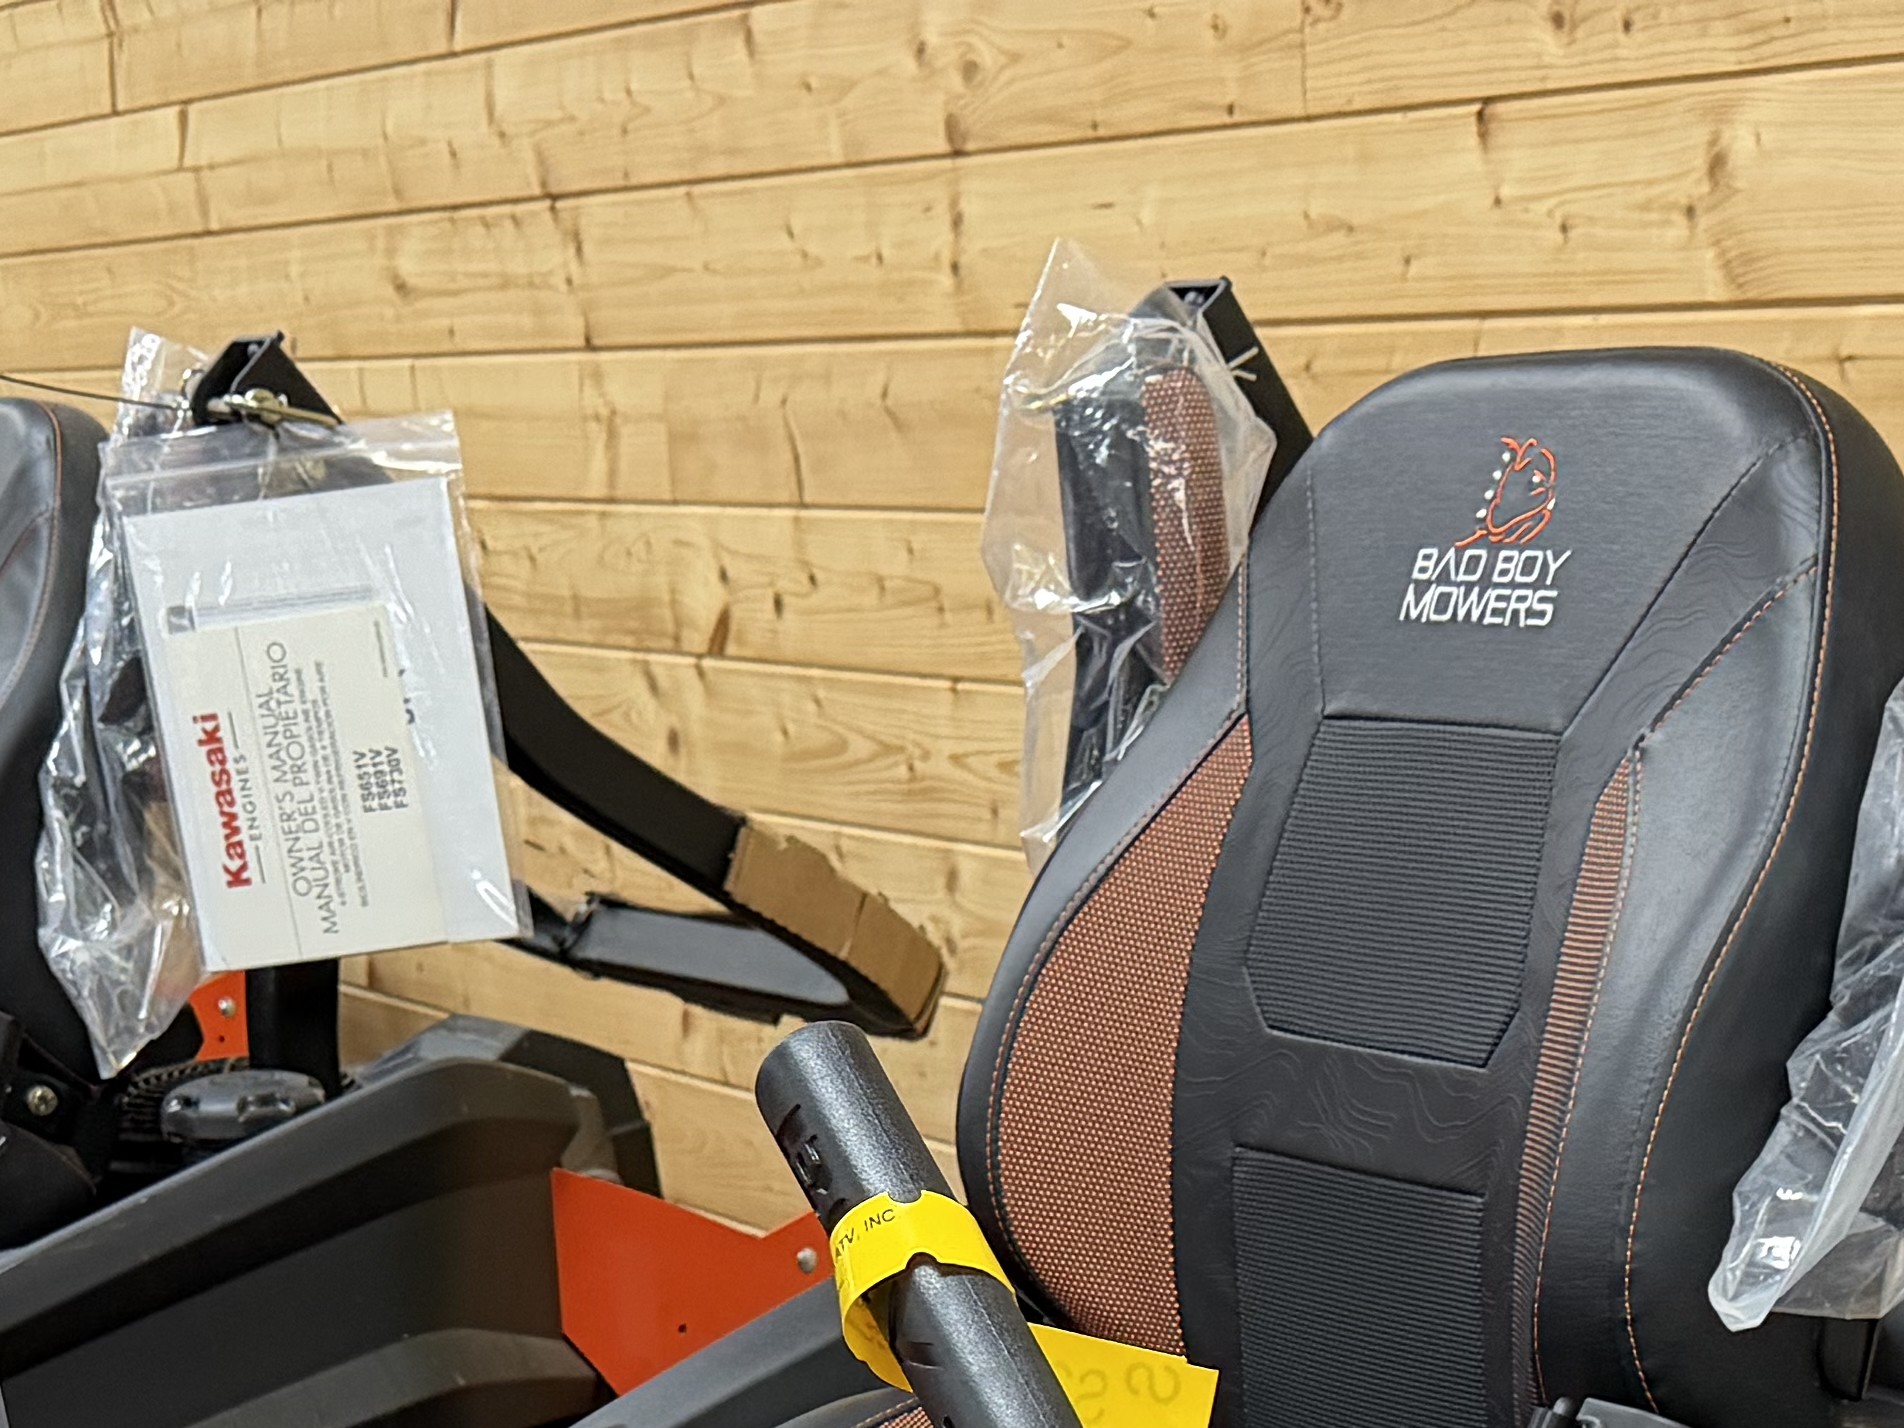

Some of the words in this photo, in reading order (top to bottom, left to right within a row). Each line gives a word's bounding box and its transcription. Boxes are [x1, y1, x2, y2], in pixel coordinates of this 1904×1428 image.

[1399, 582, 1559, 628] MOWERS
[1411, 547, 1487, 581] BAD
[1492, 549, 1572, 585] BOY
[255, 687, 293, 784] MANUAL
[265, 641, 307, 788] PROPIETARIO
[192, 712, 253, 889] Kawasaki
[232, 754, 262, 842] ENGINES
[272, 790, 314, 897] OWNER'S
[299, 789, 321, 834] DEL
[303, 836, 339, 934] MANUAL
